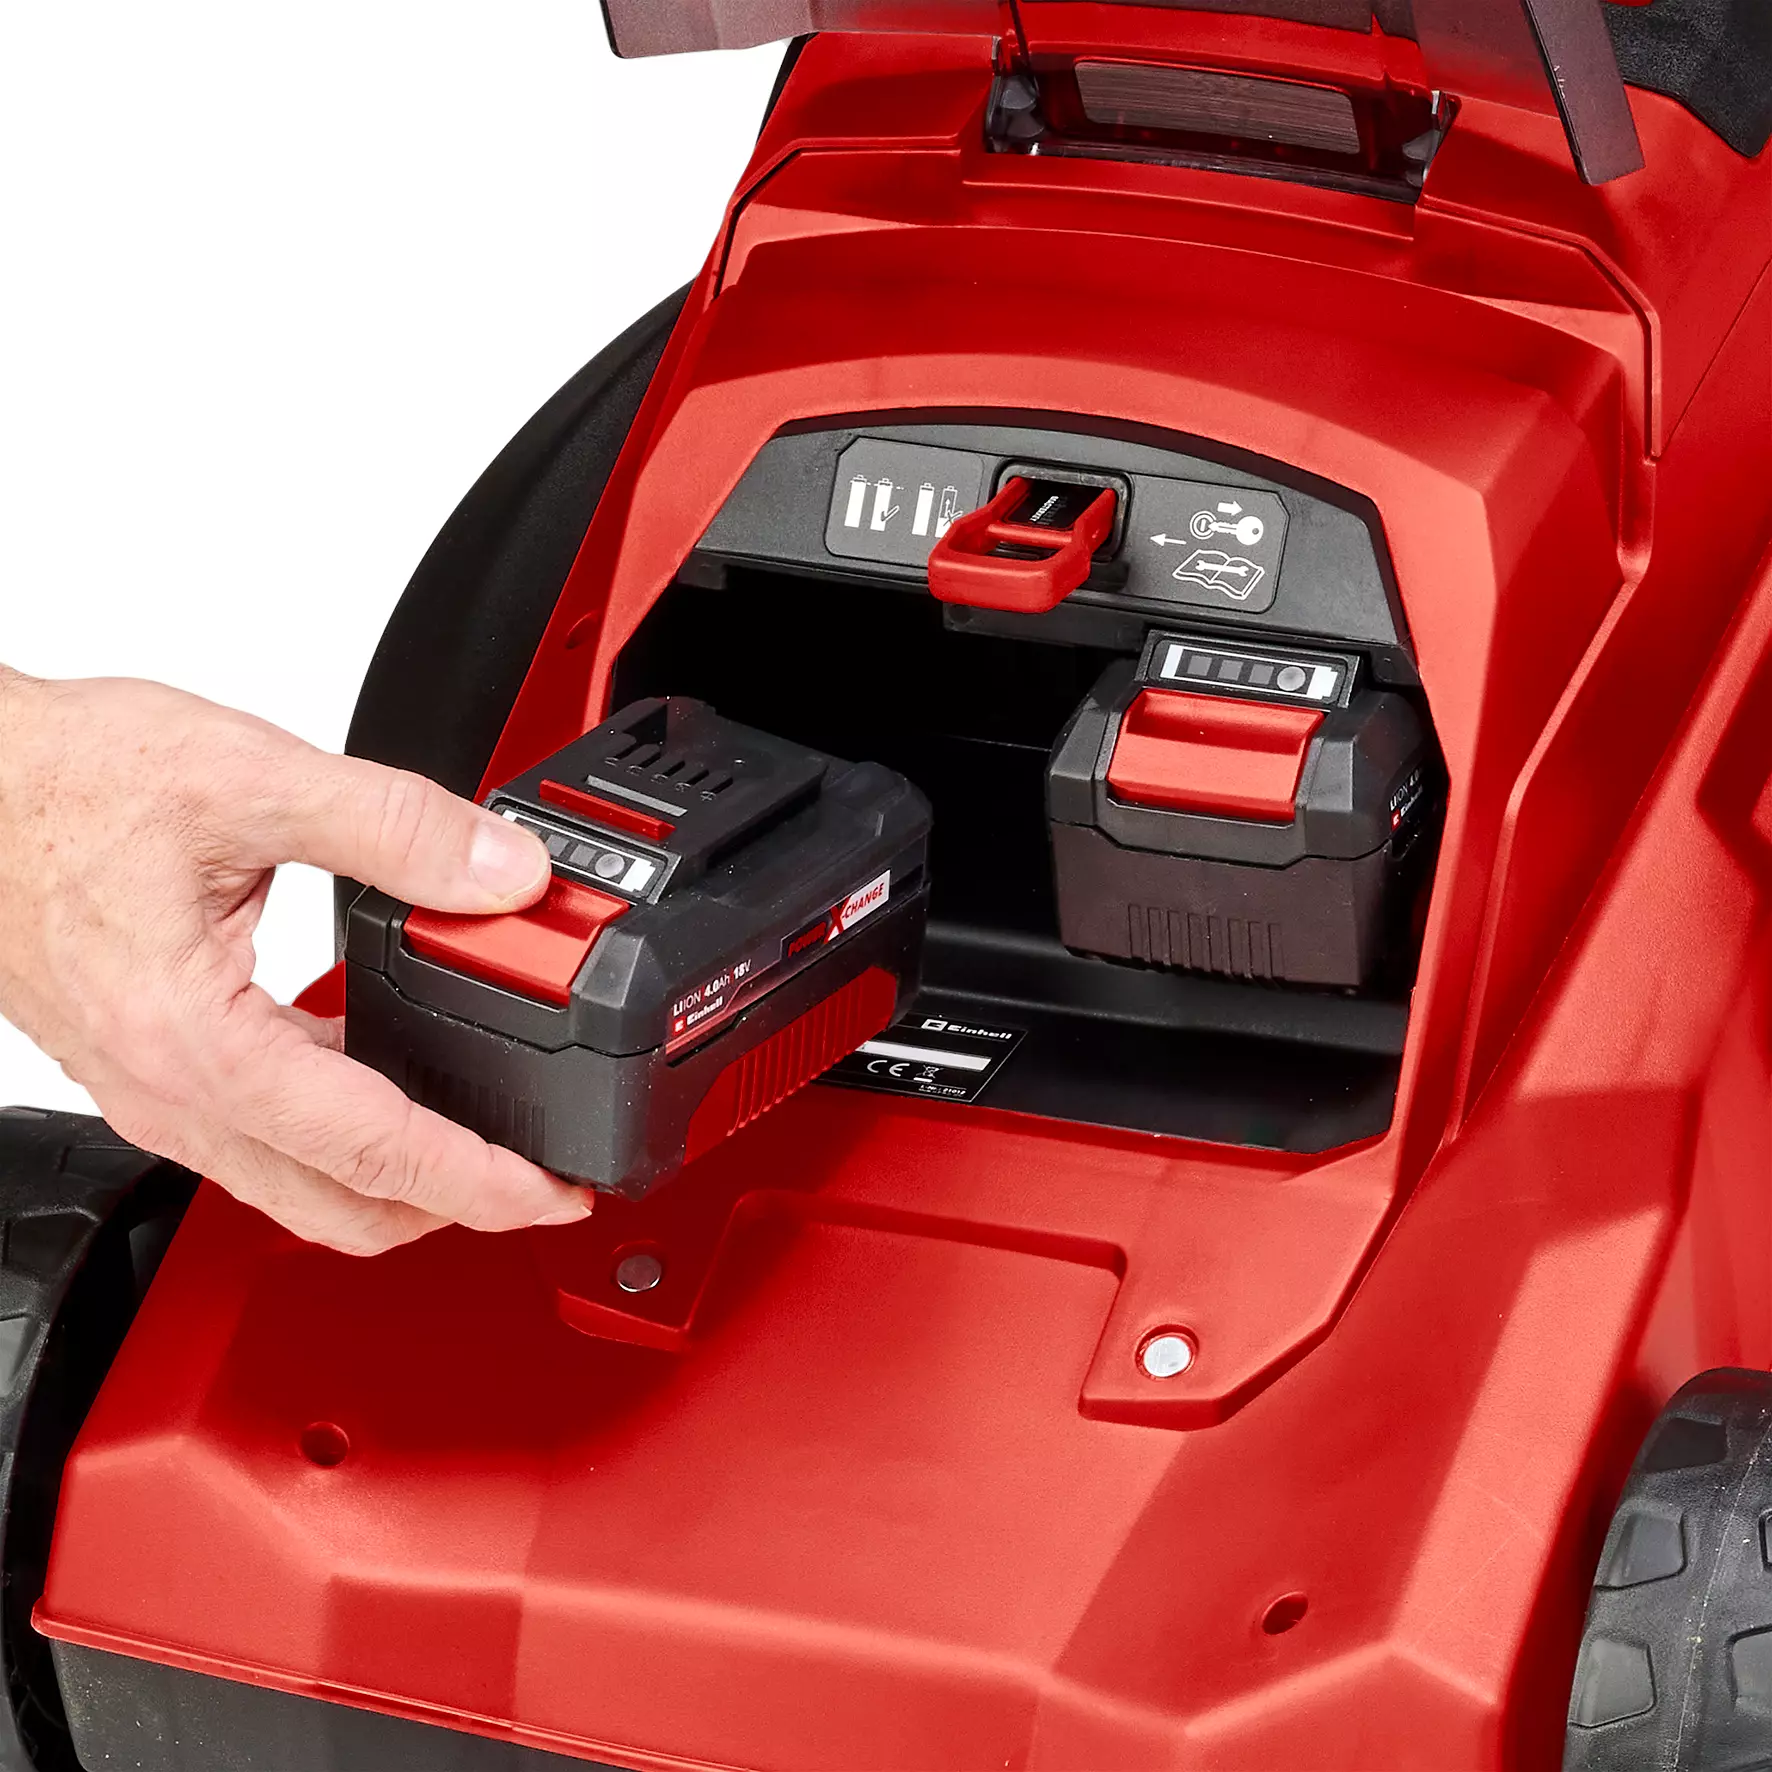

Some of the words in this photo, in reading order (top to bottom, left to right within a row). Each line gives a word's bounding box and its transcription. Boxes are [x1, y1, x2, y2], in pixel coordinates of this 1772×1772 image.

[732, 959, 752, 980] 18V
[686, 996, 723, 1026] Einhell
[947, 1024, 1012, 1040] Einhell
